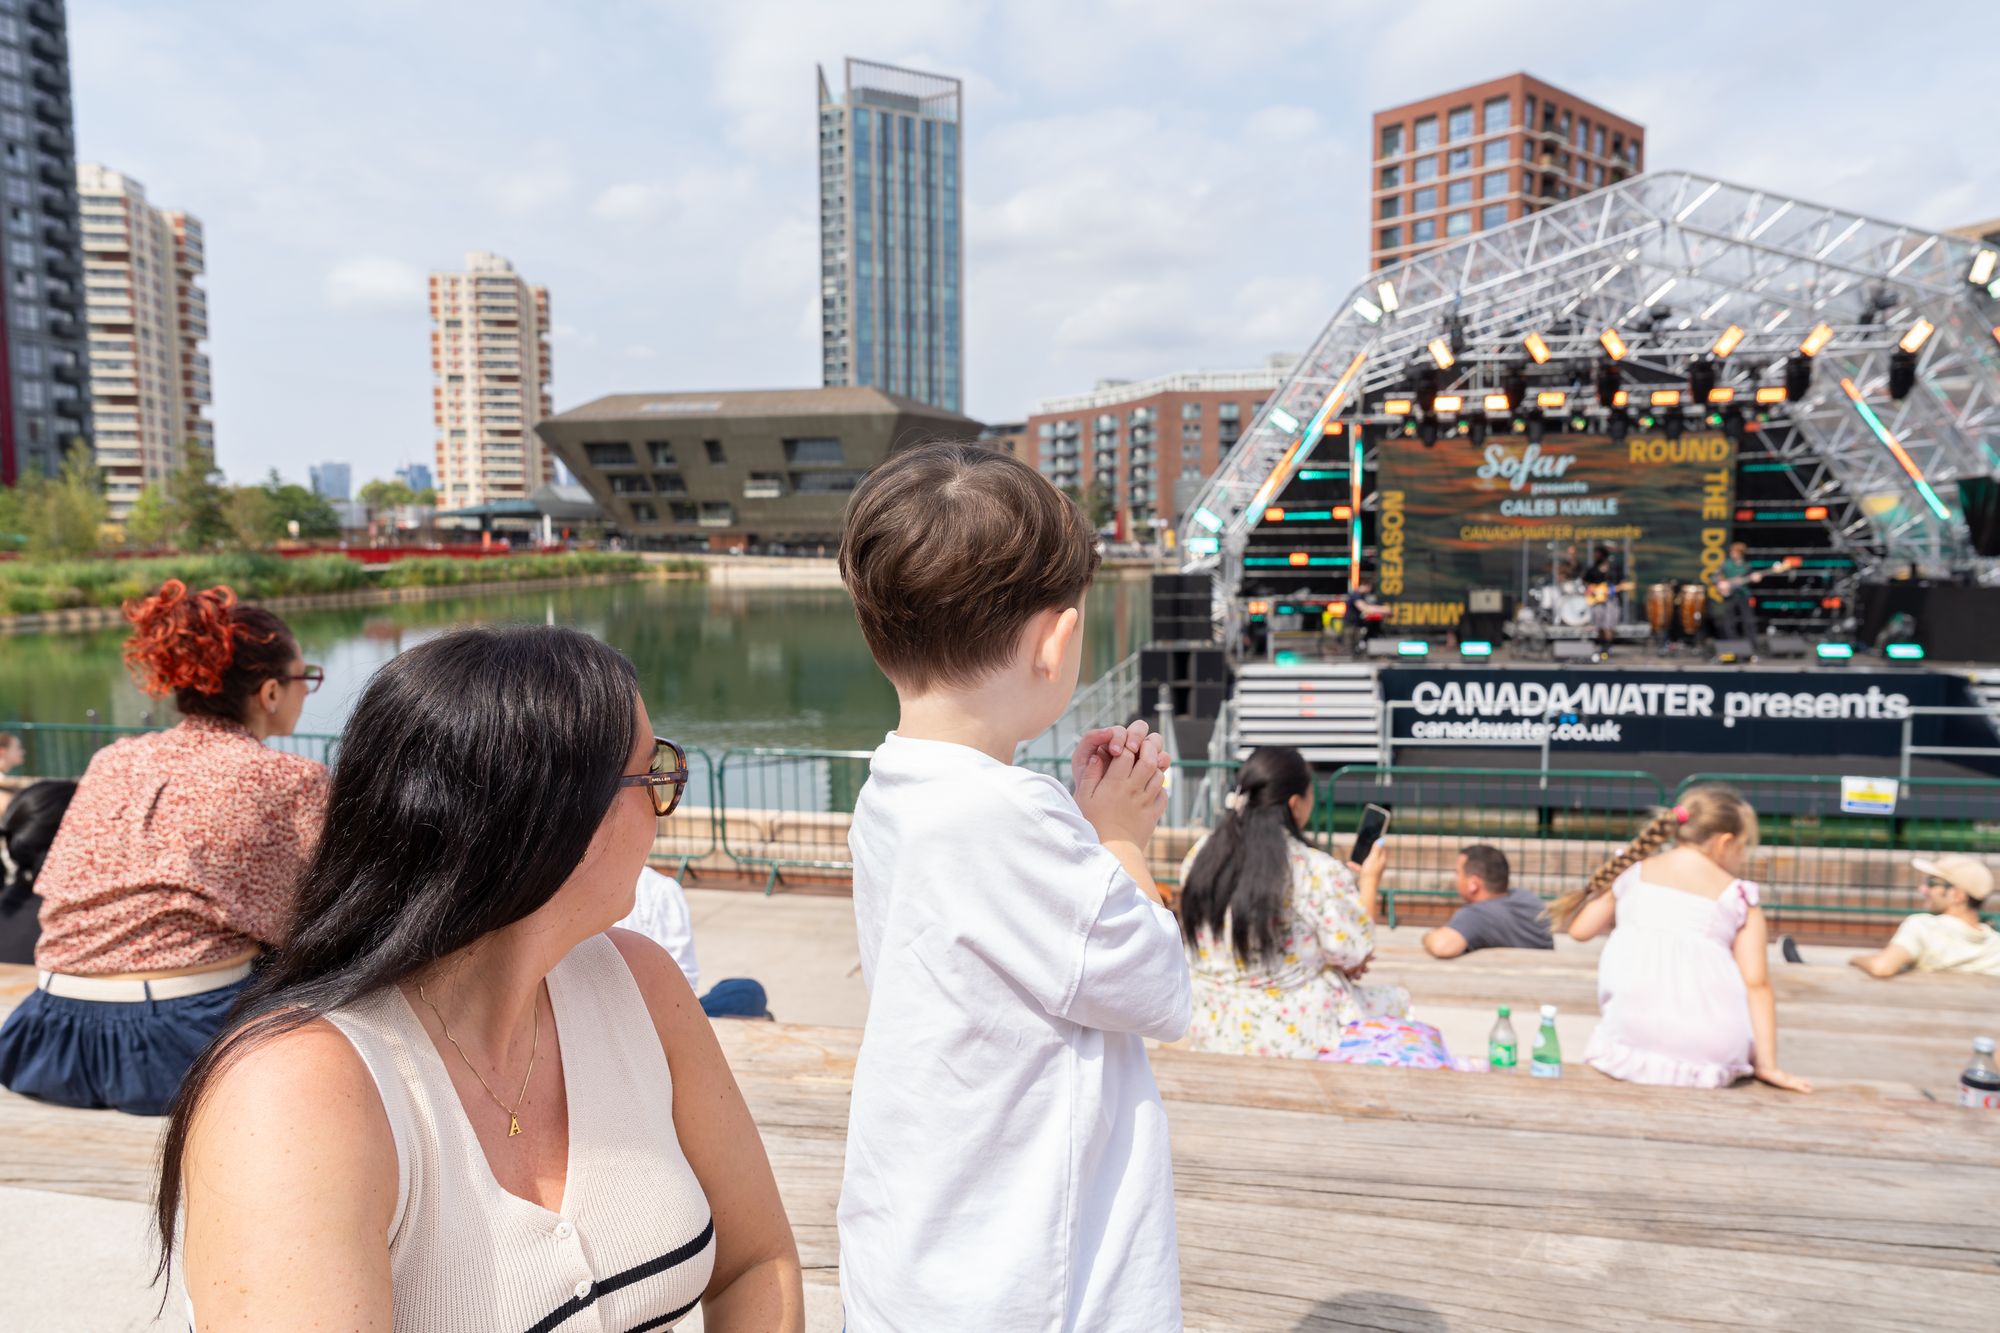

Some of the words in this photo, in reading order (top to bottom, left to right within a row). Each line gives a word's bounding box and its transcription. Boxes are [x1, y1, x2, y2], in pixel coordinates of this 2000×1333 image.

[1475, 442, 1577, 491] Sofar
[1629, 438, 1729, 463] ROUND
[1500, 499, 1557, 516] CALEB
[1560, 498, 1618, 515] KUNLE
[1702, 469, 1729, 520] THE
[1381, 490, 1405, 595] SEASON
[1724, 685, 1909, 728] presents
[1411, 718, 1621, 742] canadawater.co.uk
